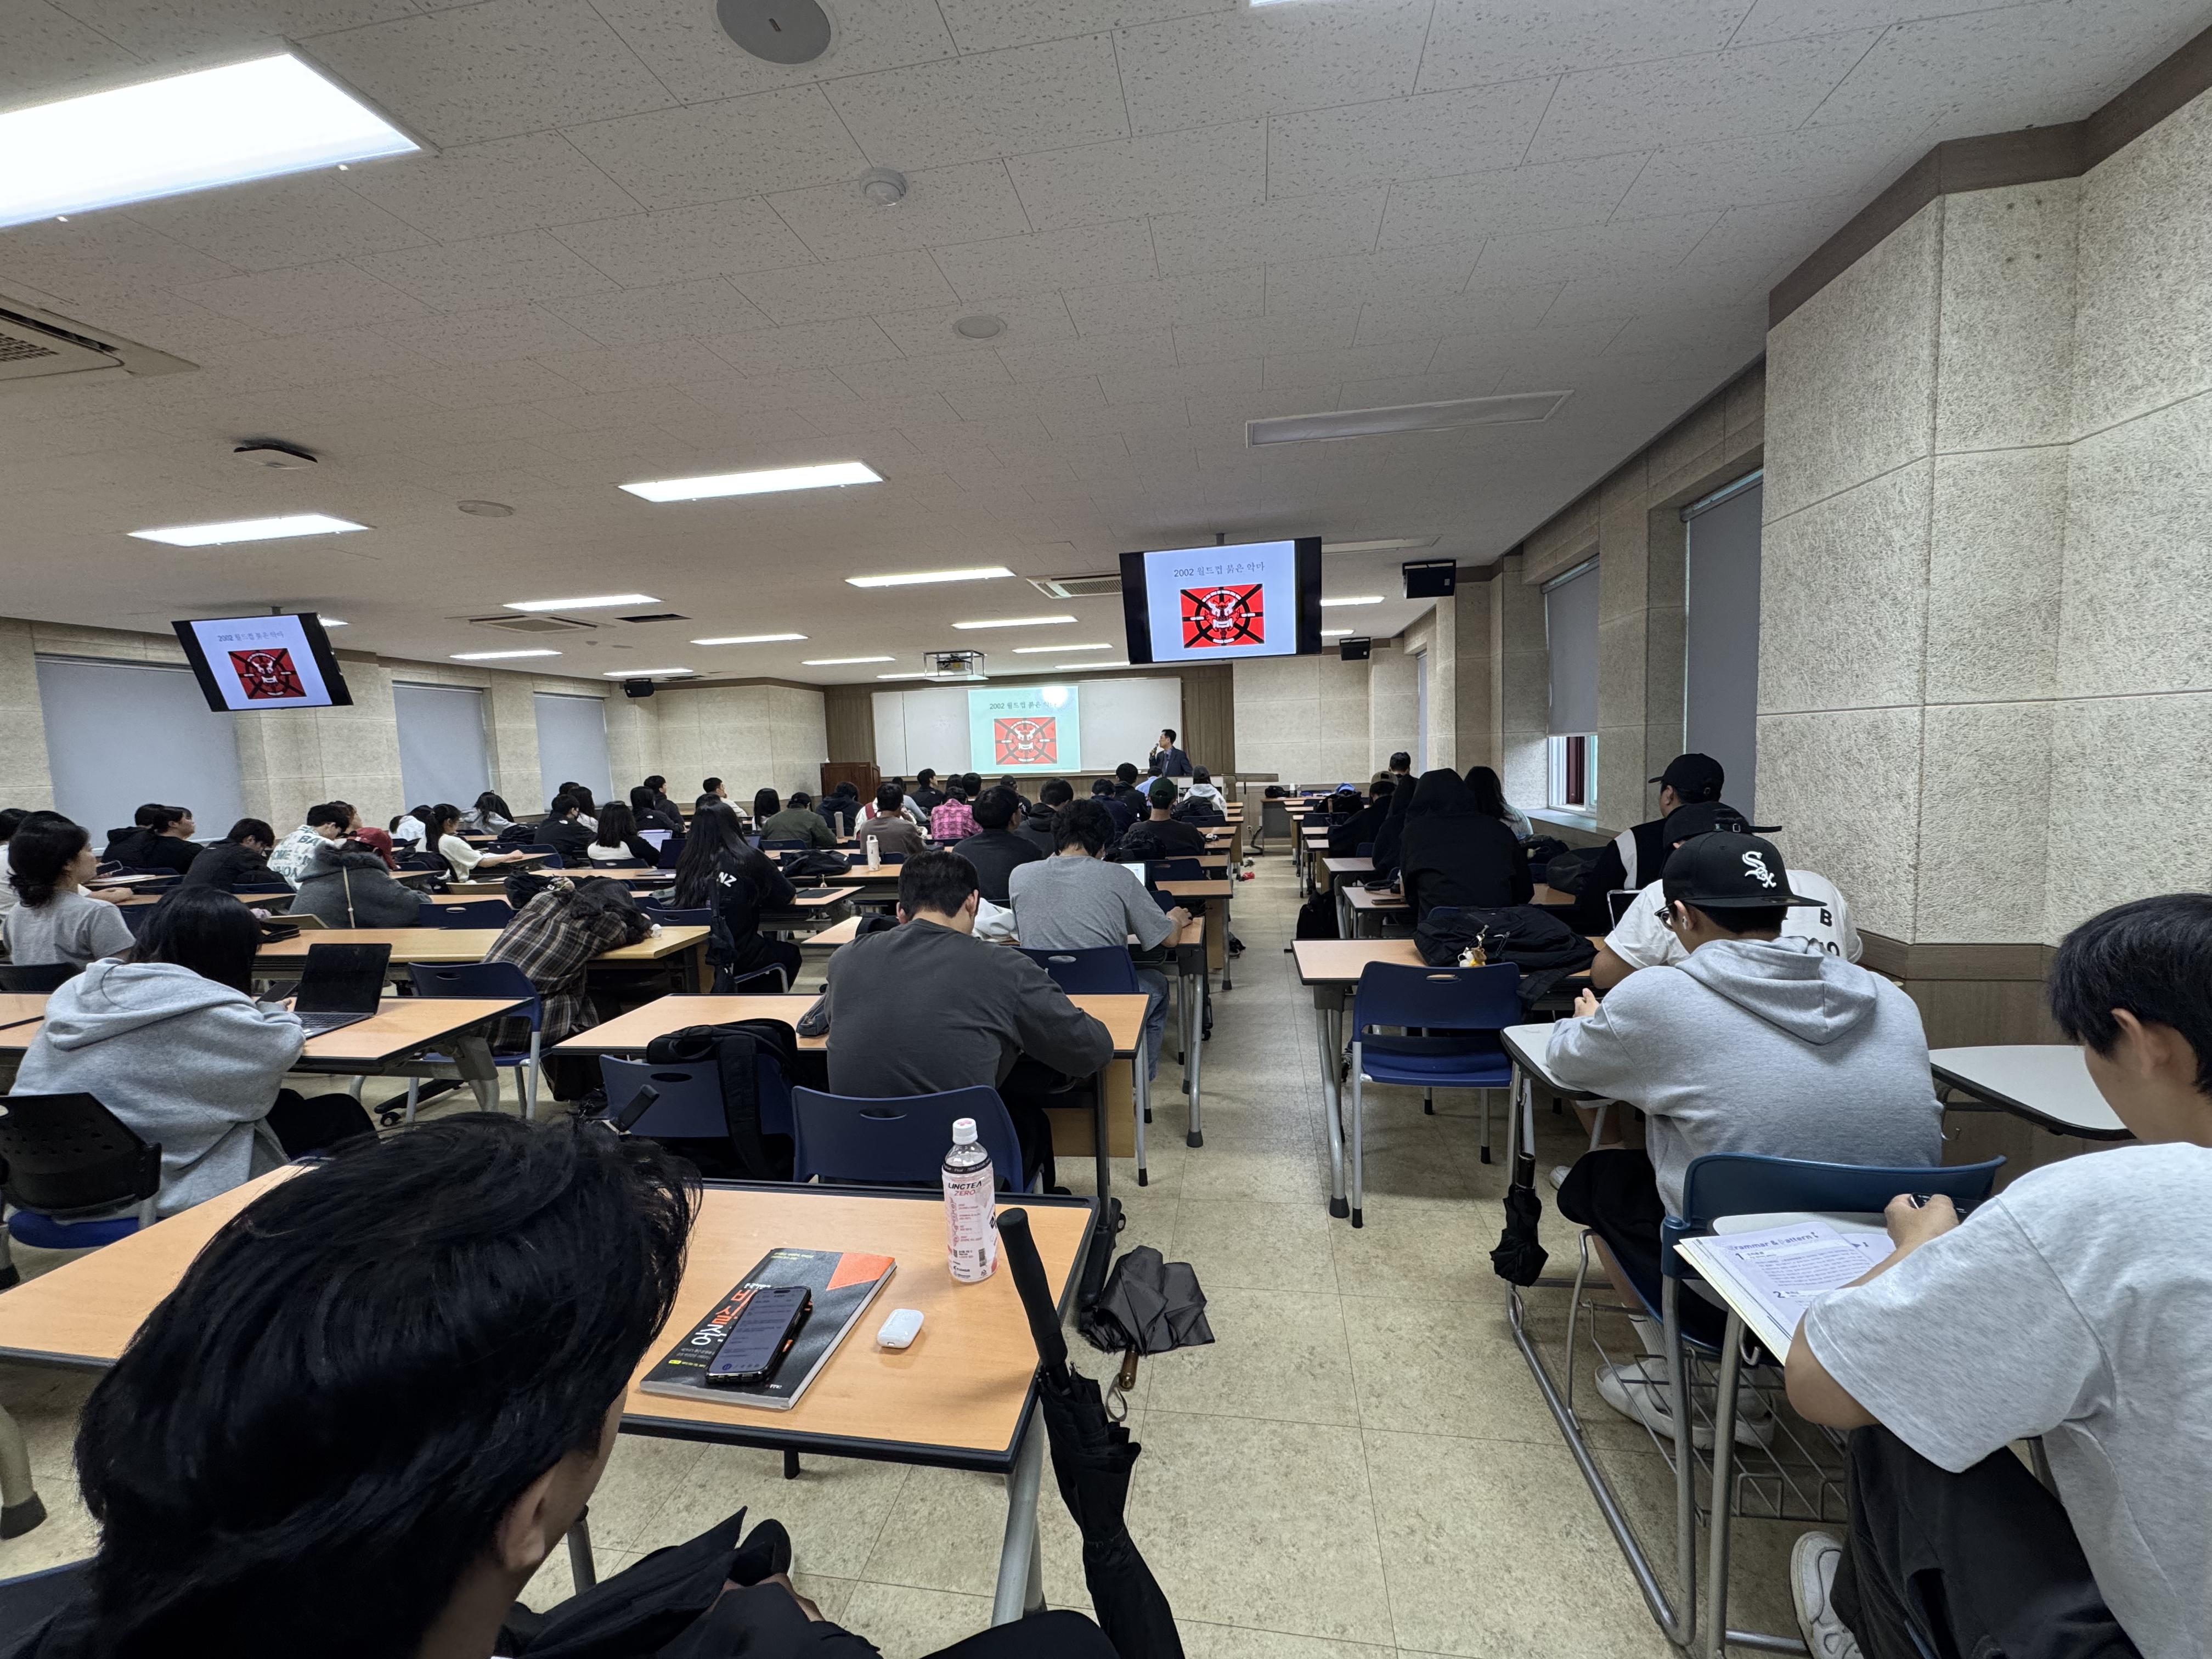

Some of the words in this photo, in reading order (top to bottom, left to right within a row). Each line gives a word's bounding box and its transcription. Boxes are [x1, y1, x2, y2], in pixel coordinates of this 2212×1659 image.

[1173, 568, 1194, 577] 2002
[1197, 565, 1223, 576] 월드컵
[1226, 563, 1244, 574] 붉은
[1246, 561, 1265, 572] 악마
[716, 872, 737, 887] NZ
